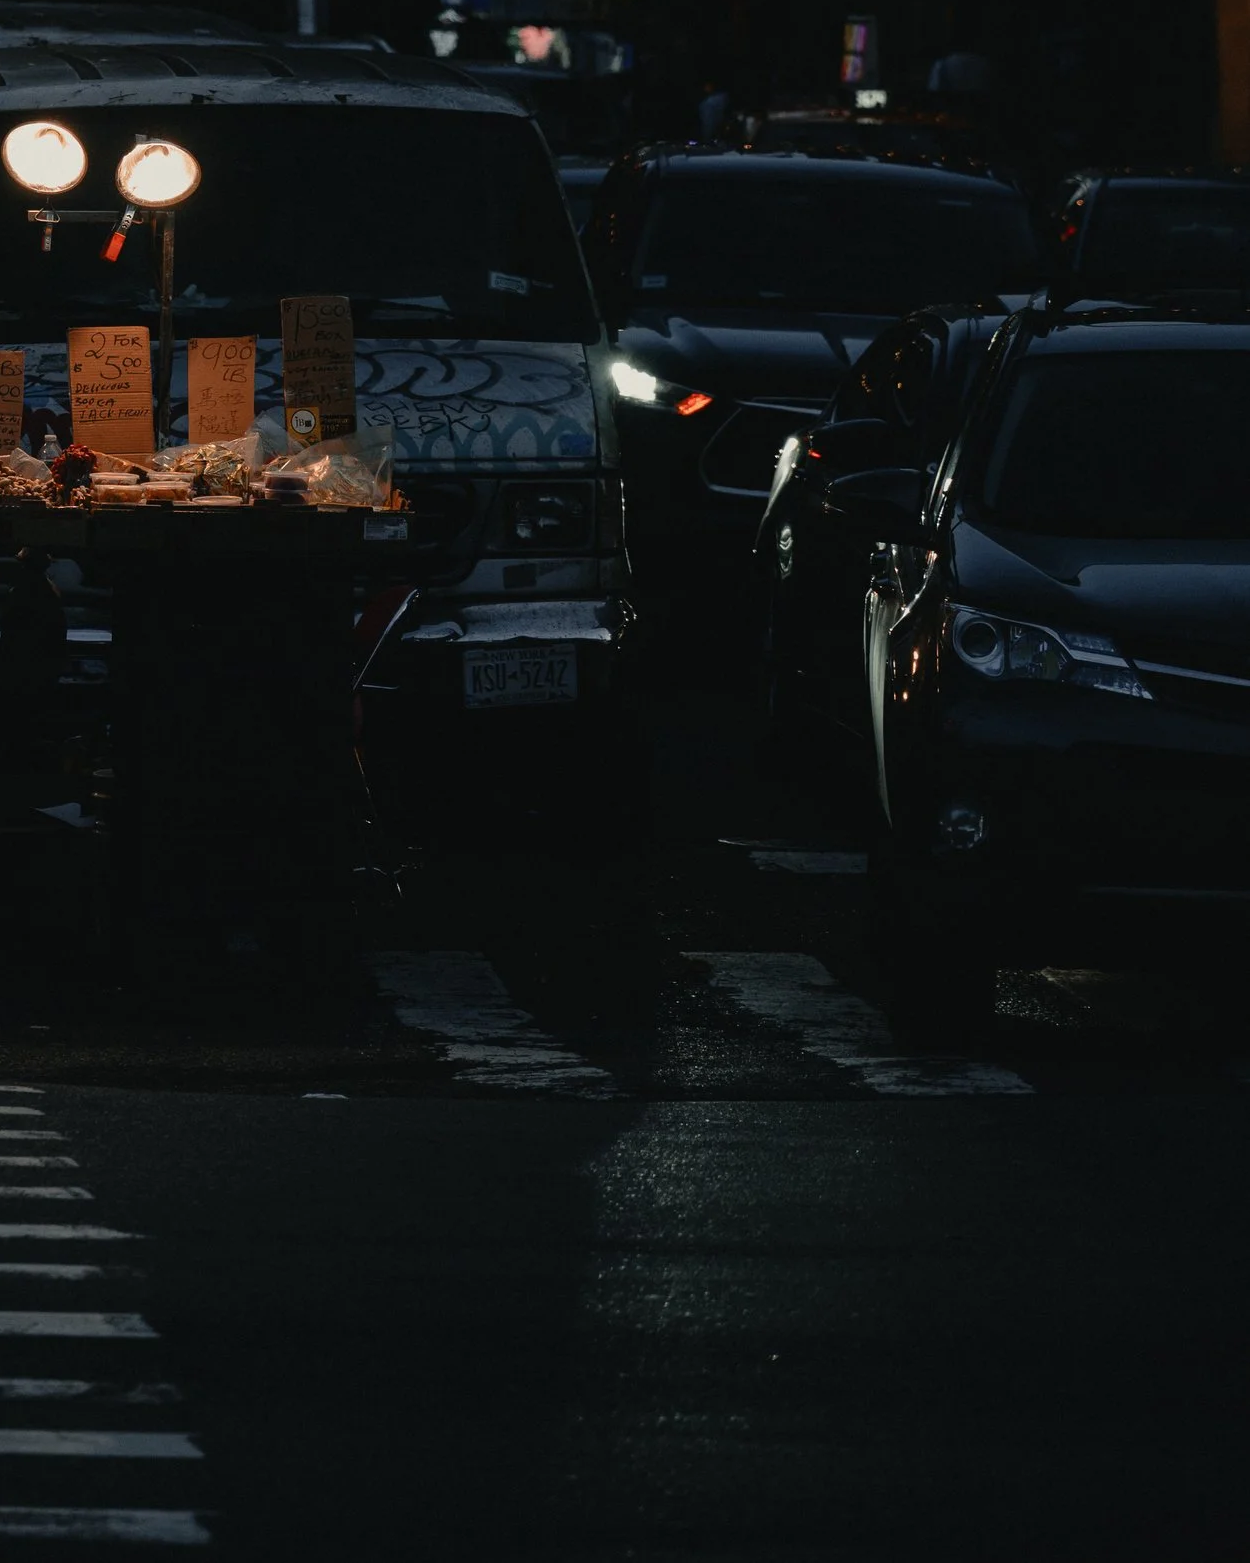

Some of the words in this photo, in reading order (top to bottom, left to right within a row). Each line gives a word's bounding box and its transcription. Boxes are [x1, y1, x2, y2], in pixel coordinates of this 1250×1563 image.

[85, 332, 106, 360] 2
[114, 334, 143, 348] FOR
[490, 651, 514, 662] NEW
[519, 649, 547, 660] YORK
[472, 663, 506, 694] KSU
[519, 658, 569, 690] 5242
